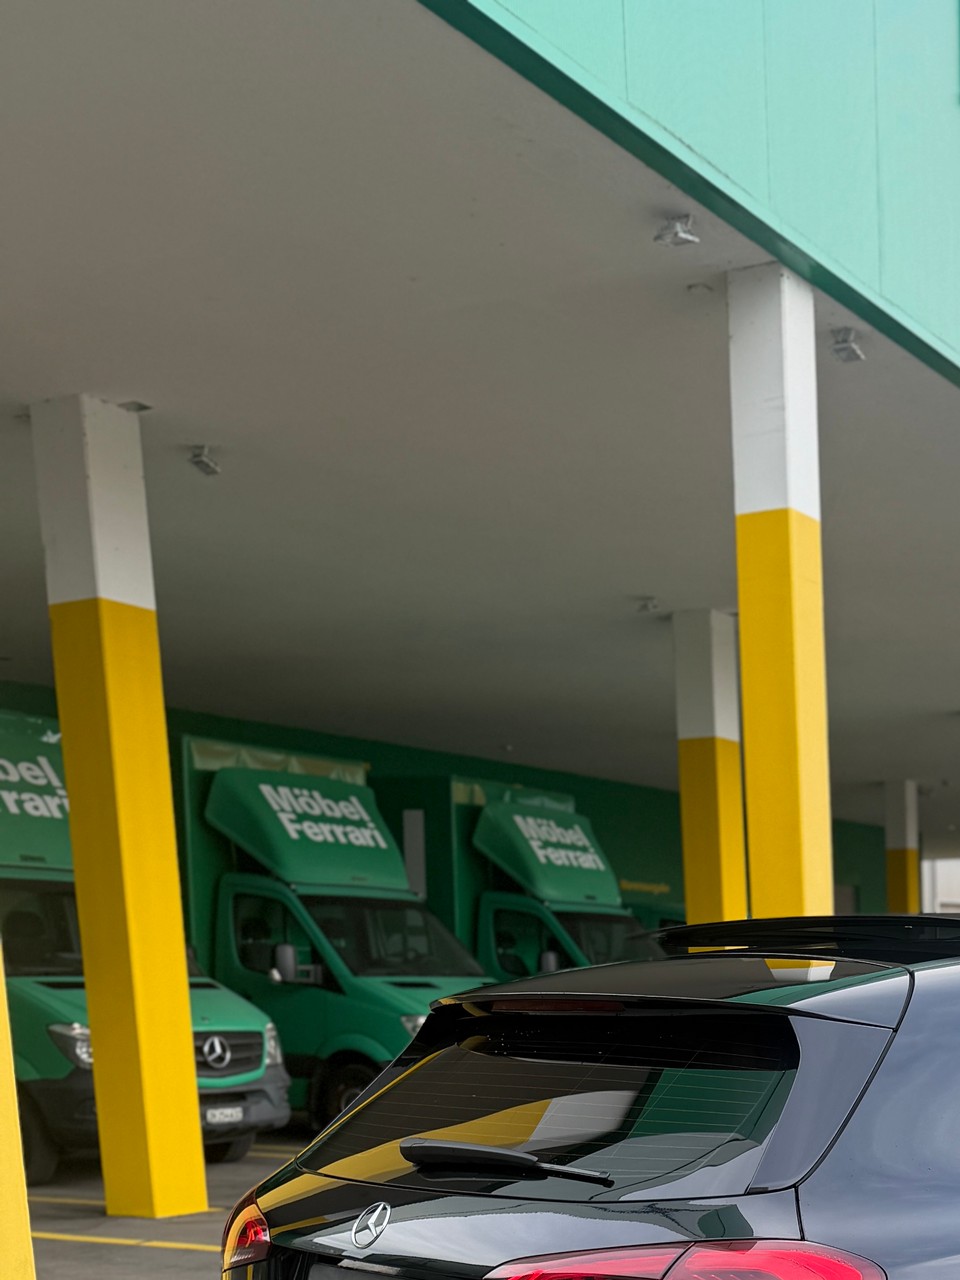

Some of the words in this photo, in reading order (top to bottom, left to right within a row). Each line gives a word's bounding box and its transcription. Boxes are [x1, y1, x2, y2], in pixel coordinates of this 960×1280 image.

[258, 784, 372, 822] Möbel
[277, 812, 388, 849] Ferrari
[513, 814, 591, 847] Möbel
[529, 839, 606, 871] Ferrari
